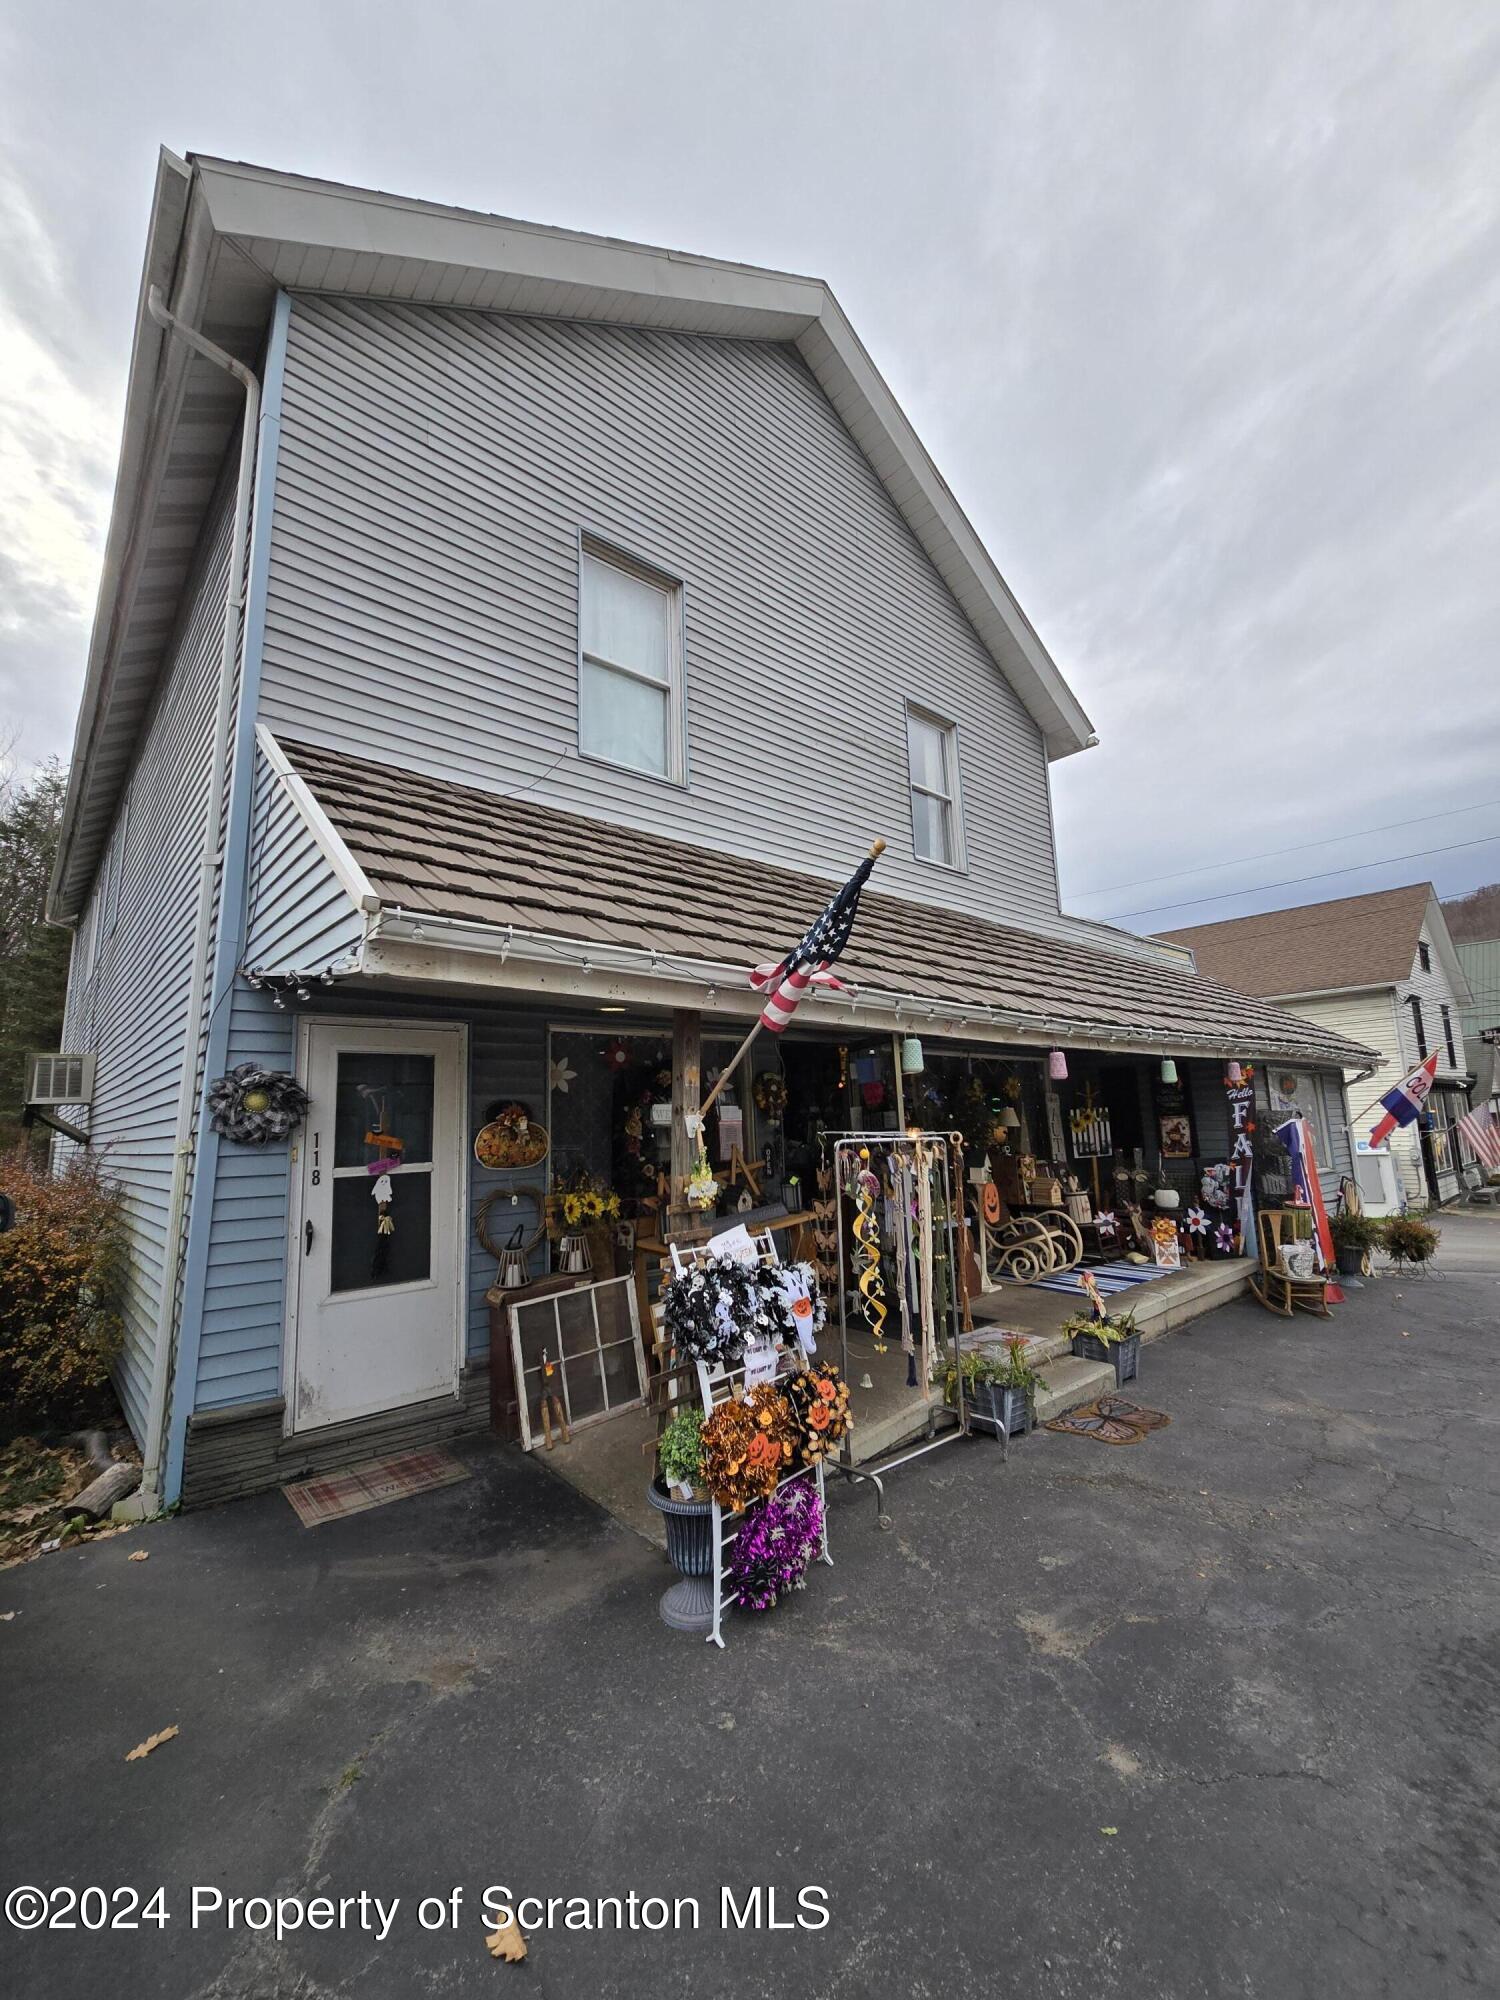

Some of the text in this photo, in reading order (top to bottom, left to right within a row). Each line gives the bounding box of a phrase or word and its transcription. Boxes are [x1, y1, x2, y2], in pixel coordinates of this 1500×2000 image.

[1226, 1087, 1254, 1101] Hello
[312, 1132, 320, 1186] 118
[1231, 1101, 1254, 1221] FALL
